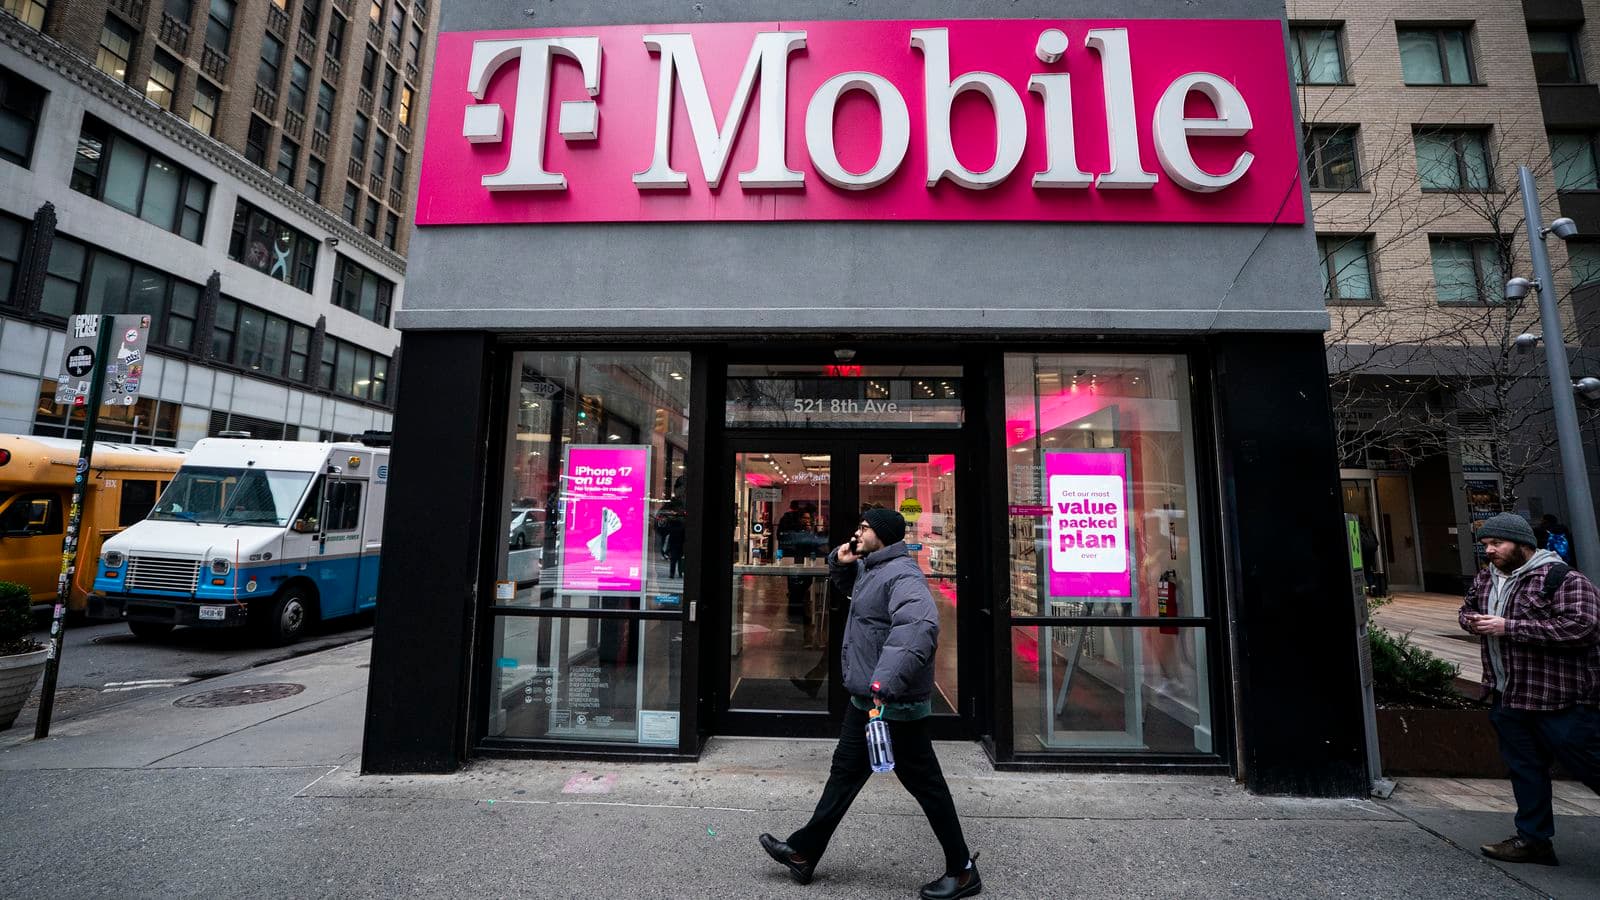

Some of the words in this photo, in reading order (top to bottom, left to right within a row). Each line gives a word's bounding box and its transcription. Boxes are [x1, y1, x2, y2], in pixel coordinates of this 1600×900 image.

[463, 37, 603, 191] T
[632, 27, 1255, 193] Mobile
[793, 399, 824, 414] 521
[831, 399, 858, 414] 8th
[863, 399, 902, 414] Ave.
[575, 466, 616, 477] iPhone
[618, 466, 633, 477] 17
[574, 477, 593, 486] on
[596, 477, 613, 486] us
[1057, 498, 1118, 515] value
[1058, 516, 1118, 530] packed
[1060, 530, 1116, 552] plan
